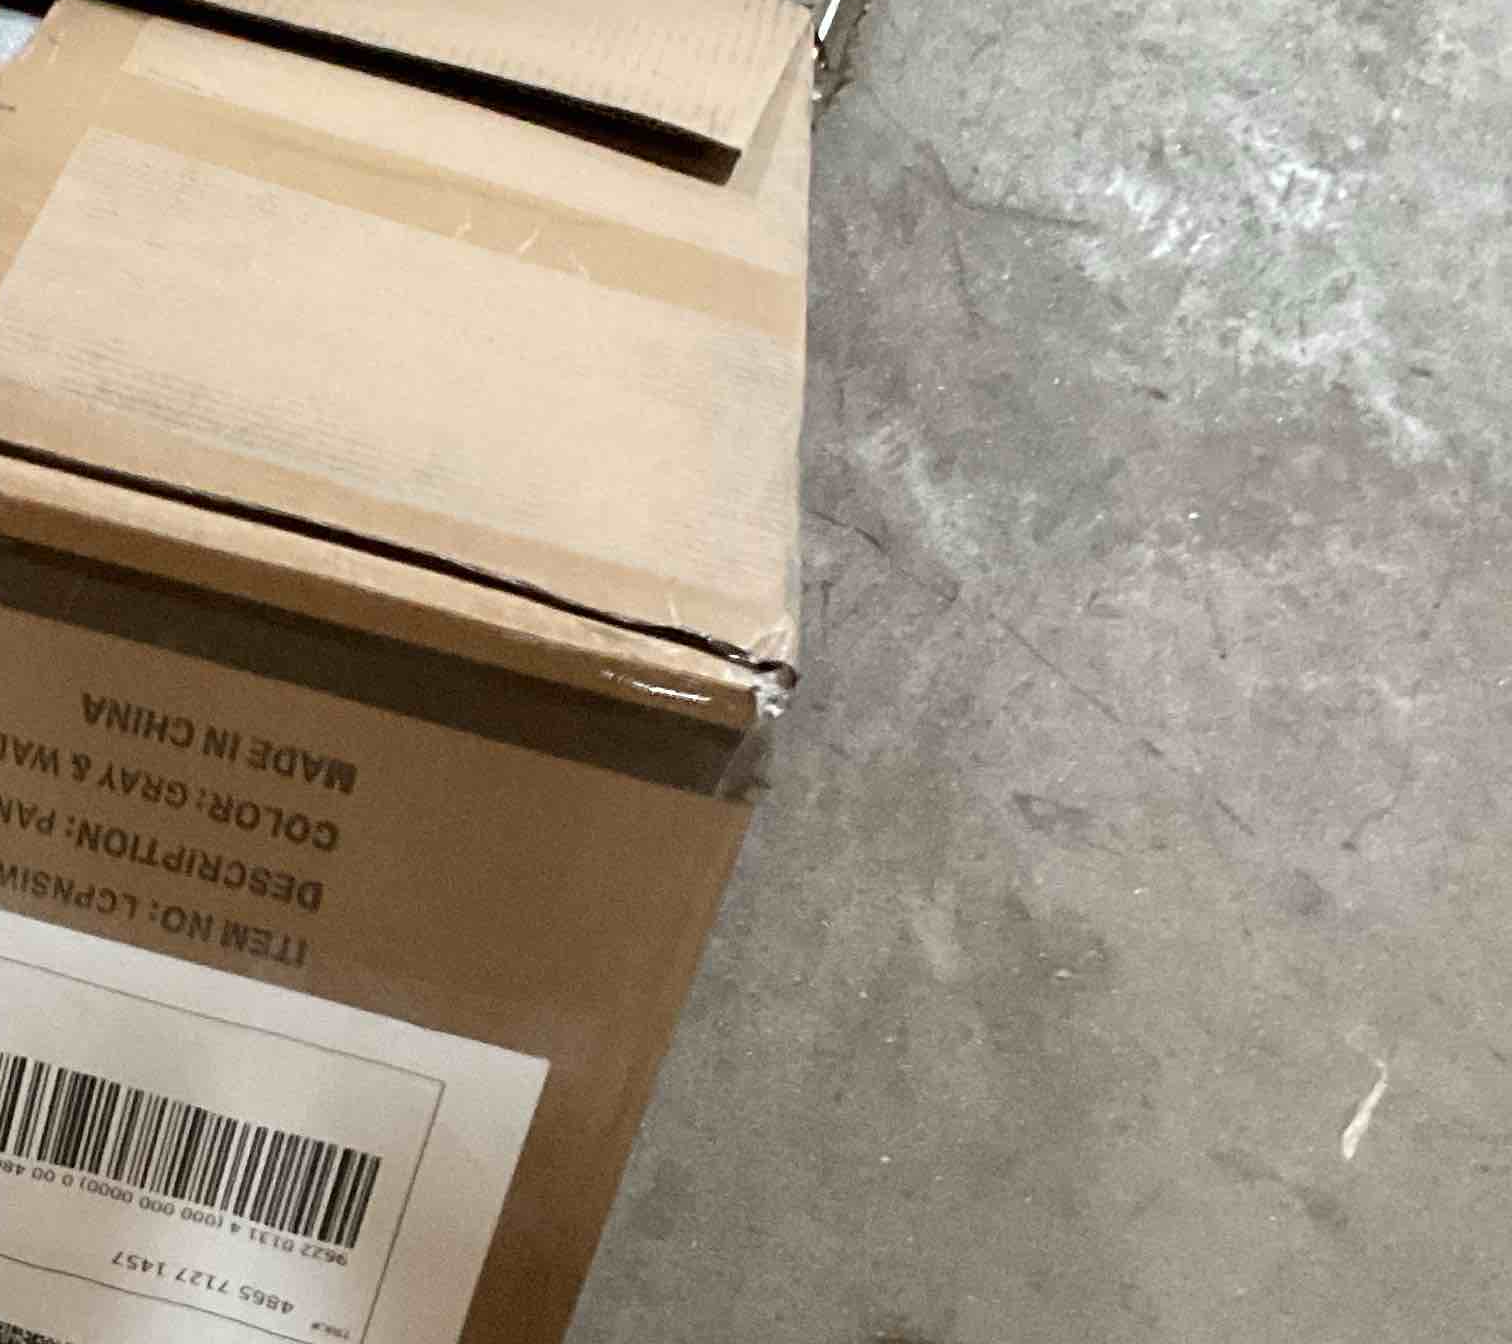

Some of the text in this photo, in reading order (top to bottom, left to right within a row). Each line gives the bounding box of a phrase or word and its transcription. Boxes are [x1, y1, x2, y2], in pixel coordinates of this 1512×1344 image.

[67, 753, 92, 782] &
[77, 693, 357, 795] MADE IN CHINA
[97, 762, 188, 810] GRAY
[196, 789, 339, 853] COLOR:
[65, 816, 323, 912] DESCRIPTION:
[148, 899, 214, 942] NO:
[220, 920, 308, 968] ITEM
[32, 1167, 55, 1182] 00
[139, 1196, 174, 1215] 000
[301, 1243, 347, 1266] 9622
[112, 1250, 294, 1313] 4865 7127 1457
